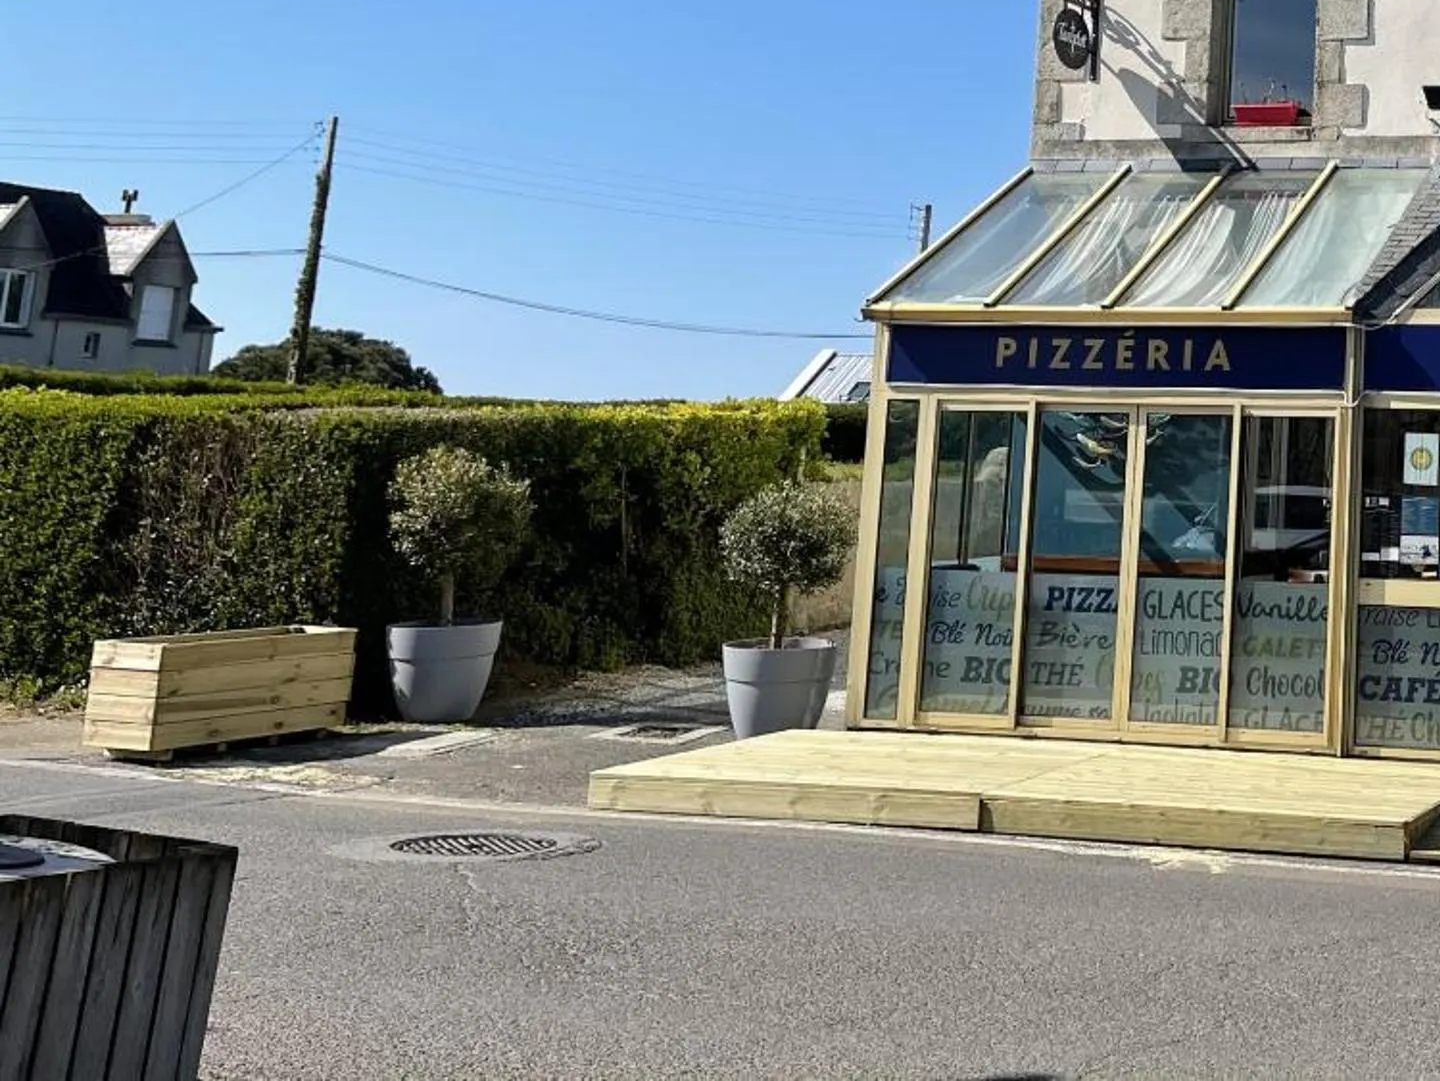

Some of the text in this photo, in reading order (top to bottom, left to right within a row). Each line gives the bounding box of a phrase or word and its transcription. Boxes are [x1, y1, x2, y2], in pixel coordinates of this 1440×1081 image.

[996, 329, 1231, 371] PIZZÉRIA
[1043, 586, 1118, 613] PIZZ
[1143, 589, 1224, 622] GLACES
[931, 620, 966, 645] Blé
[1372, 639, 1410, 664] Blé
[1031, 656, 1084, 686] THÉ
[1176, 666, 1220, 694] BI
